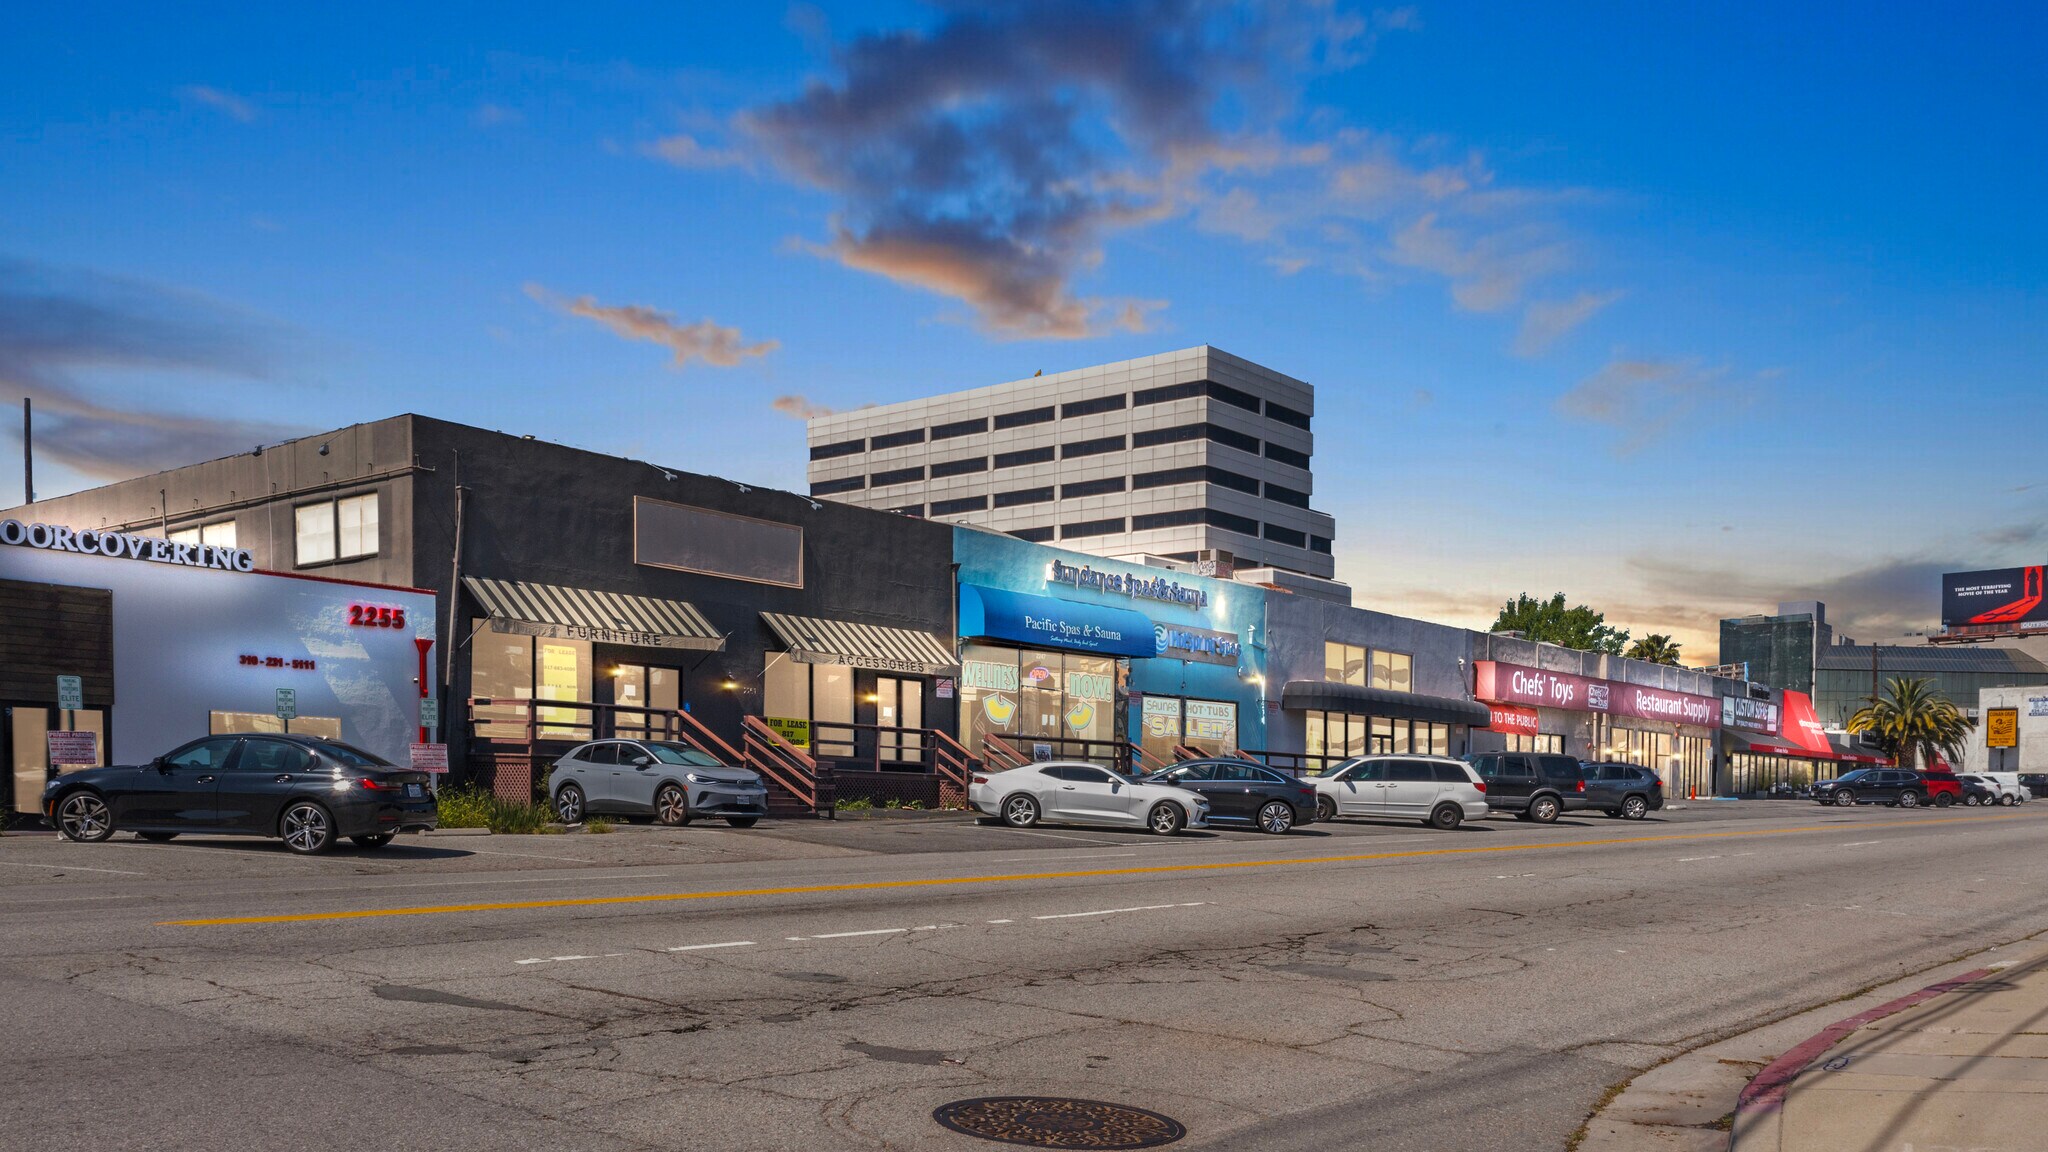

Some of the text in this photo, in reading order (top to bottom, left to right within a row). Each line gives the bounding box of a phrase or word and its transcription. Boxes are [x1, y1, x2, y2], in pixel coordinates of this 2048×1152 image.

[349, 605, 406, 630] 2255
[567, 625, 661, 646] FURNITURE
[1025, 616, 1121, 641] Pacific Spas & Sauna
[838, 656, 924, 672] ACCESSORIES
[1031, 669, 1047, 680] OPEN
[1512, 671, 1574, 705] Chefs' Toys
[1636, 690, 1711, 724] Restaurant Supply
[769, 719, 782, 727] FOR
[1494, 712, 1502, 723] TO
[1504, 713, 1515, 725] THE
[1516, 715, 1537, 728] PUBLIC
